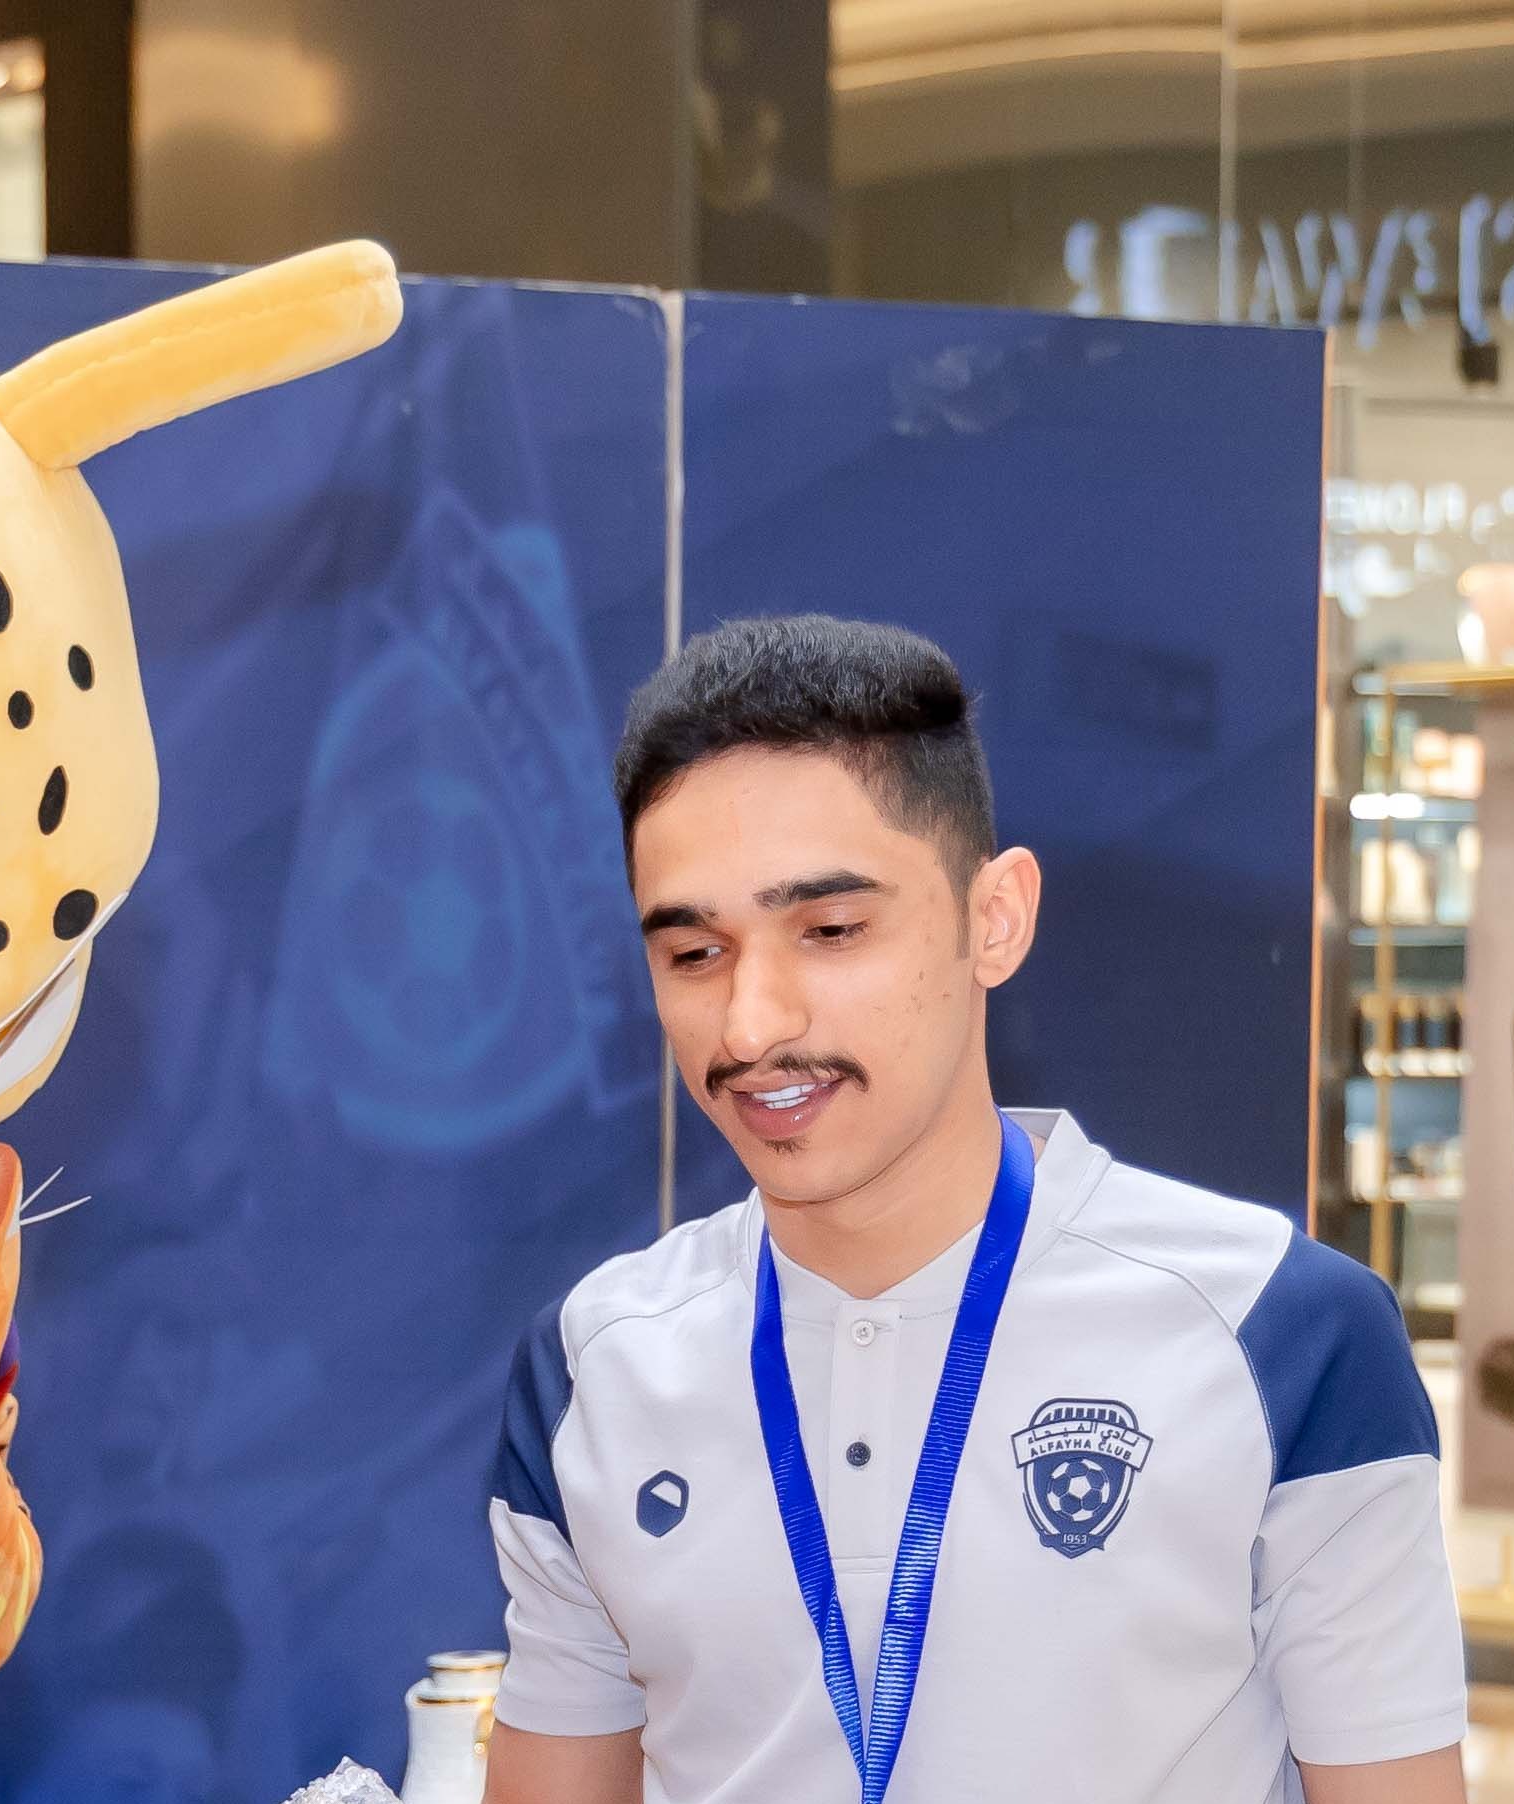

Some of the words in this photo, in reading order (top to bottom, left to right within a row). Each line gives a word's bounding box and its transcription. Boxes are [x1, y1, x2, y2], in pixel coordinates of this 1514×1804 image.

[1030, 1439, 1092, 1458] ALFAYHA
[1098, 1440, 1132, 1460] CLUB
[1062, 1533, 1088, 1545] 1953
